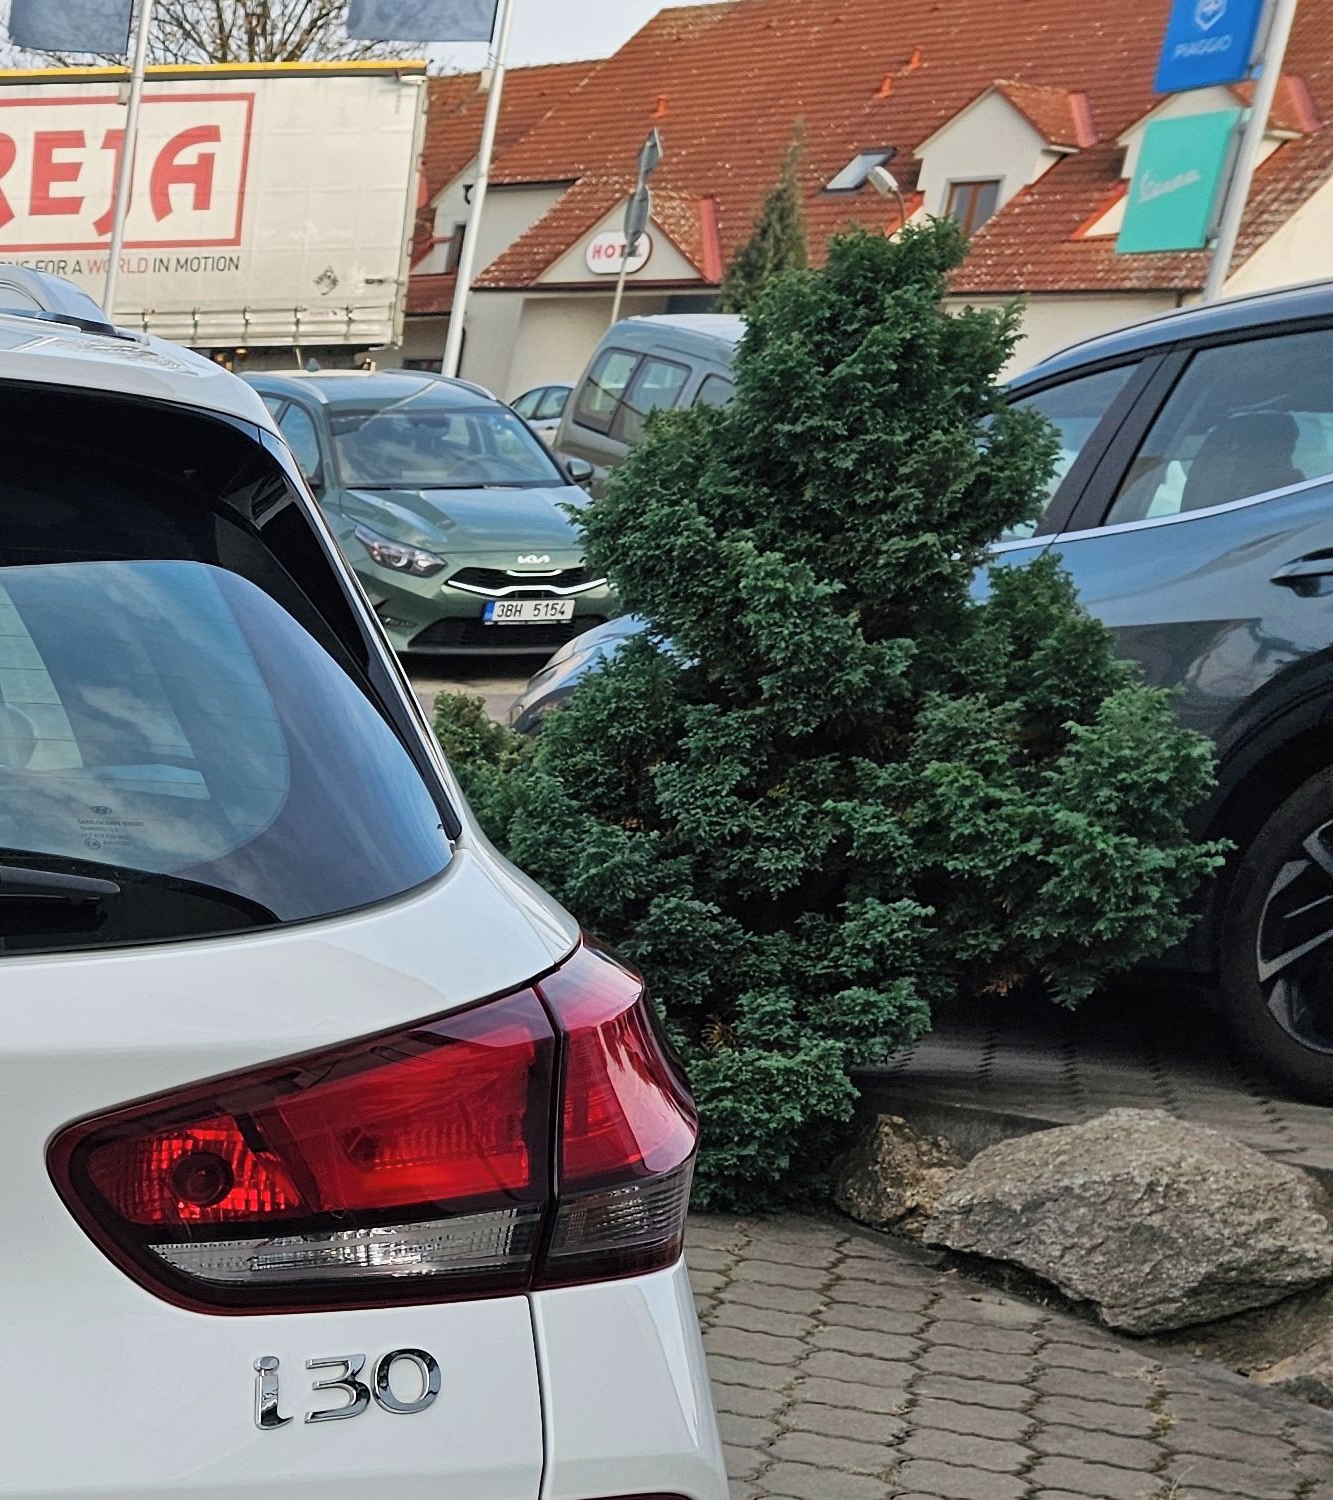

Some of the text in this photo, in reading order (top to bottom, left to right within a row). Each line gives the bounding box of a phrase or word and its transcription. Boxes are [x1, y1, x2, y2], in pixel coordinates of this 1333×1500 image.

[592, 243, 643, 259] HOTL
[71, 260, 83, 274] A
[152, 257, 170, 273] IN
[174, 256, 240, 273] MOTION
[497, 603, 565, 617] 3BH 5154
[253, 1348, 442, 1430] i30
